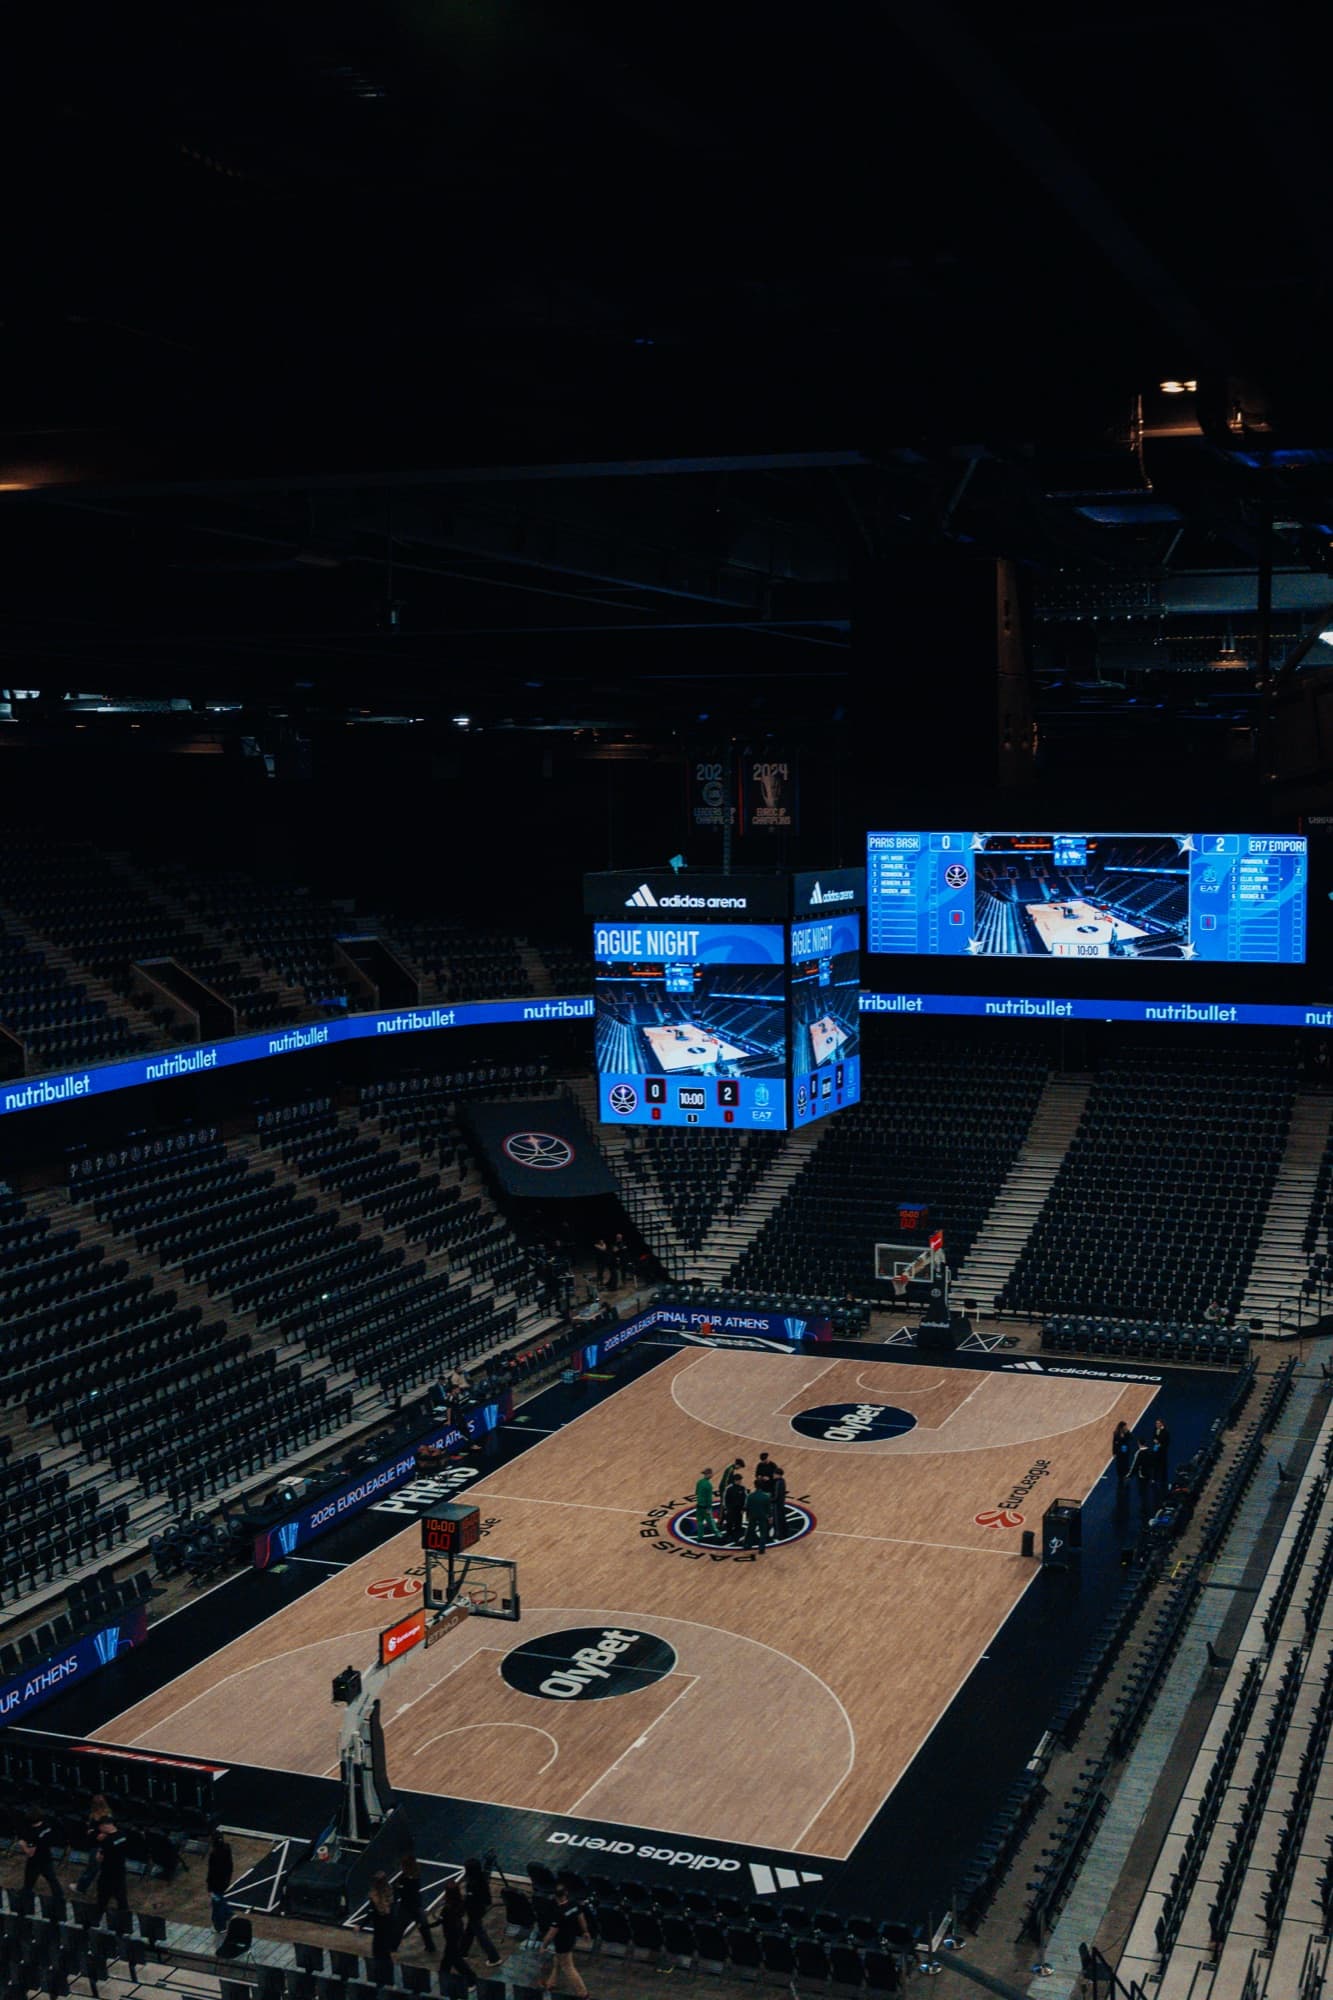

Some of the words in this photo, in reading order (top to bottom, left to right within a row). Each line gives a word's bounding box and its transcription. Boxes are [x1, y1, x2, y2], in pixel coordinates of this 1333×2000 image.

[696, 763, 723, 781] 202
[752, 763, 788, 781] 2024
[942, 835, 951, 849] 0
[1216, 837, 1225, 852] 2
[1250, 841, 1268, 852] EA7
[659, 895, 706, 908] adidas
[707, 897, 747, 909] arena
[594, 929, 642, 956] AGUE
[646, 931, 700, 956] NIGHT
[1077, 945, 1099, 956] 10:00
[524, 1000, 595, 1018] nutribull
[985, 999, 1073, 1016] nutribullet
[1145, 1004, 1237, 1021] nutribullet
[376, 1010, 455, 1033] nutribullet
[269, 1026, 329, 1054] nutribullet
[146, 1049, 217, 1079] nutribullet
[5, 1075, 91, 1109] nutribullet
[651, 1084, 660, 1098] 0
[724, 1087, 732, 1101] 2
[656, 1311, 688, 1324] FINAL
[691, 1314, 722, 1327] FOUR
[724, 1317, 769, 1330] ATHENS
[1048, 1367, 1108, 1377] adidas
[1109, 1371, 1163, 1381] arena
[823, 1404, 886, 1441] OlyBet
[310, 1502, 336, 1528] 2026
[337, 1467, 396, 1512] EUROLEAGUE
[395, 1456, 417, 1477] FINA
[998, 1459, 1051, 1510] EuroLeague
[426, 1519, 457, 1534] 10:00
[538, 1629, 640, 1698] OlyBet
[24, 1655, 78, 1701] ATHENS
[546, 1831, 636, 1855] arena
[636, 1845, 742, 1872] adidas
